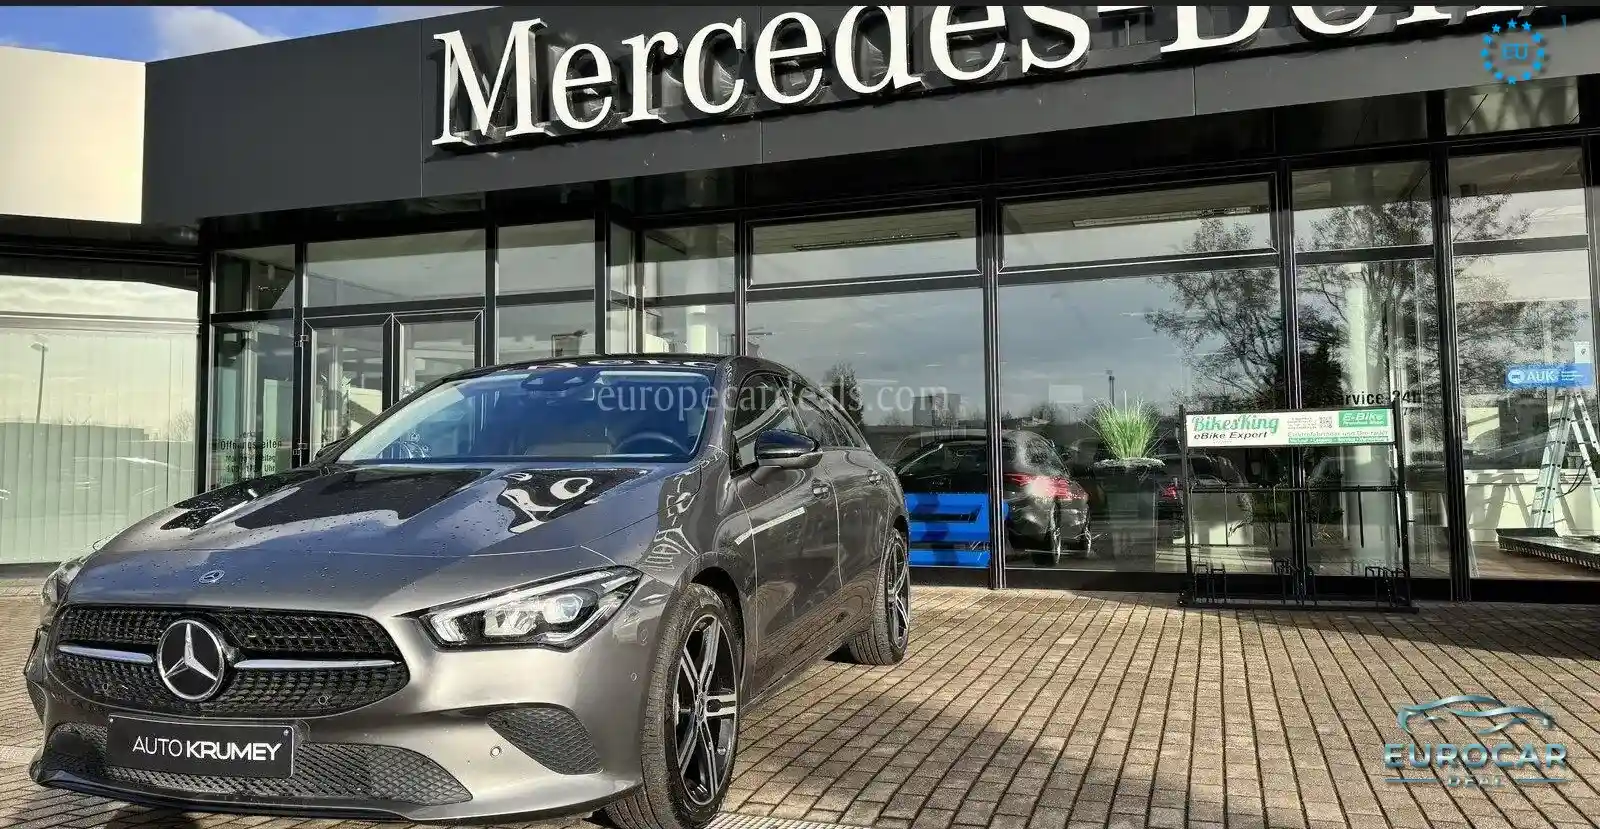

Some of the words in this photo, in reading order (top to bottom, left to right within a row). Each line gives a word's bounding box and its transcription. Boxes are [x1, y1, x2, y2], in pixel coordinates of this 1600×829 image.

[431, 6, 1549, 146] Mercedes-
[1192, 415, 1280, 434] BikesKing
[1194, 432, 1226, 440] eBike
[1229, 431, 1268, 440] Expert
[132, 735, 183, 757] AUTO
[187, 740, 282, 761] KRUMEY
